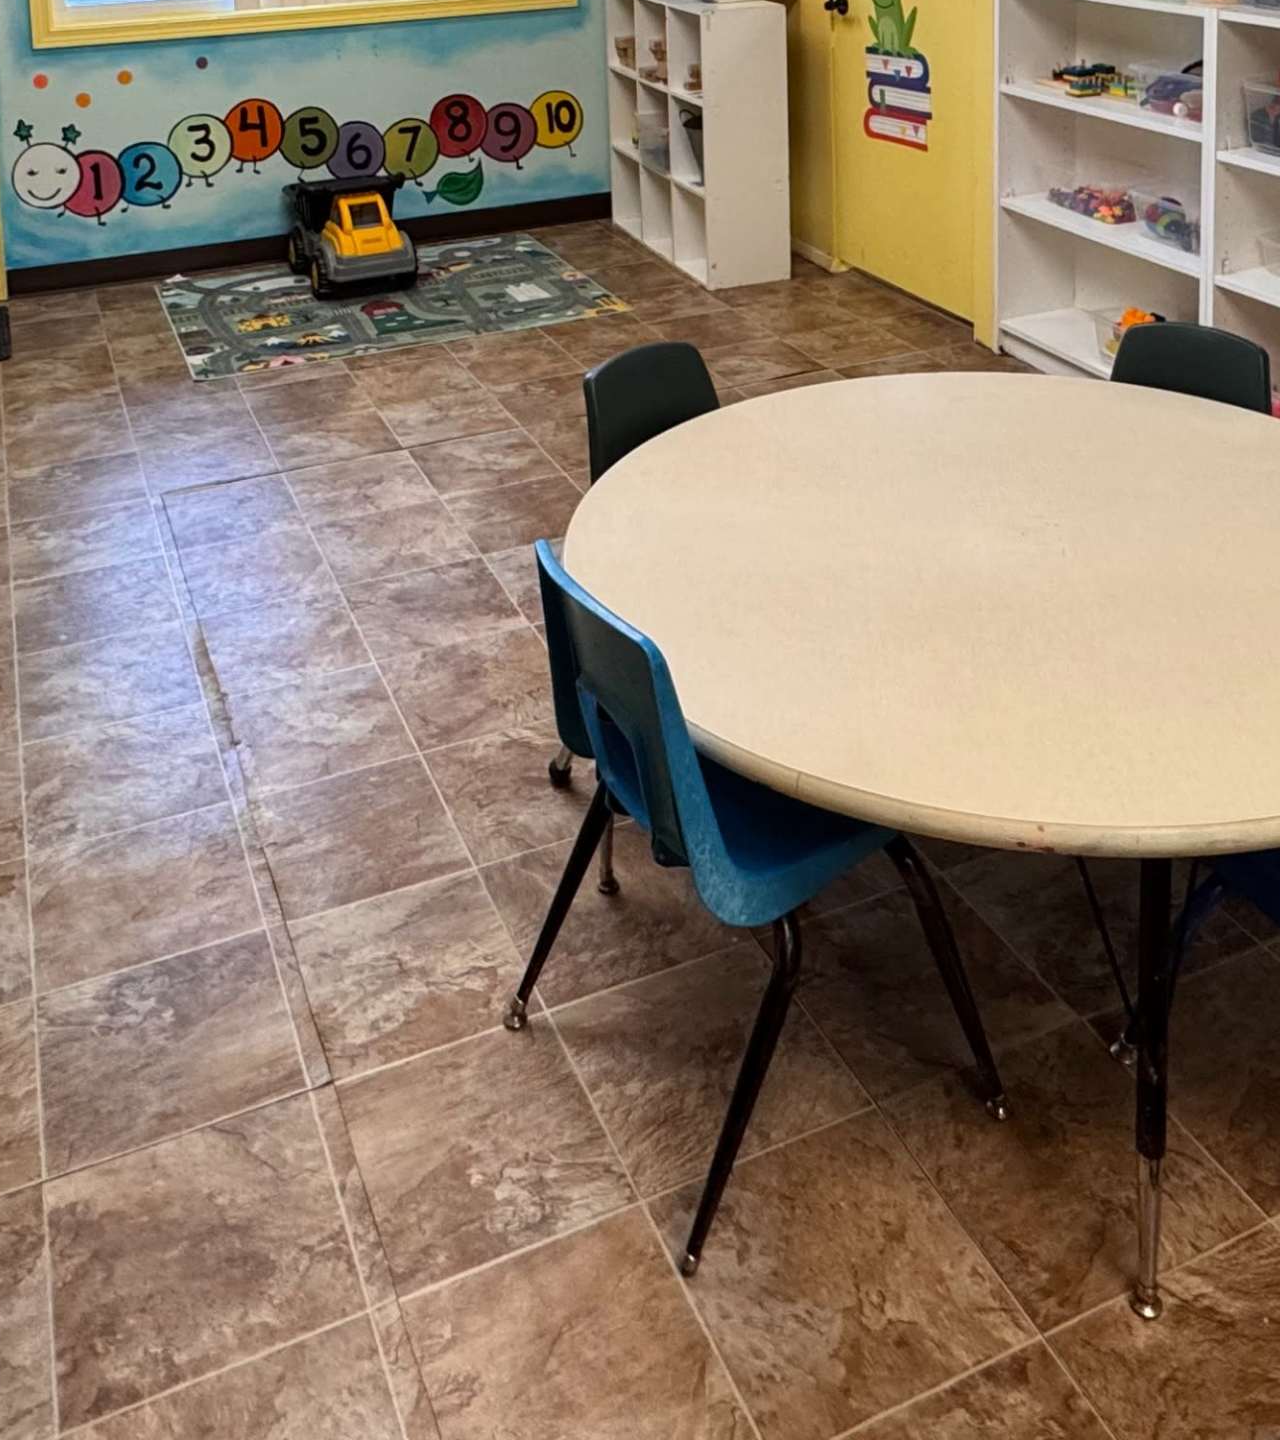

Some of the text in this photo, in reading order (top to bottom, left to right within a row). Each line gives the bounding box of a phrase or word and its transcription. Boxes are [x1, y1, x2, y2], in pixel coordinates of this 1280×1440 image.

[90, 99, 577, 201] 1 2 3 4 5 6 7 8 9 10
